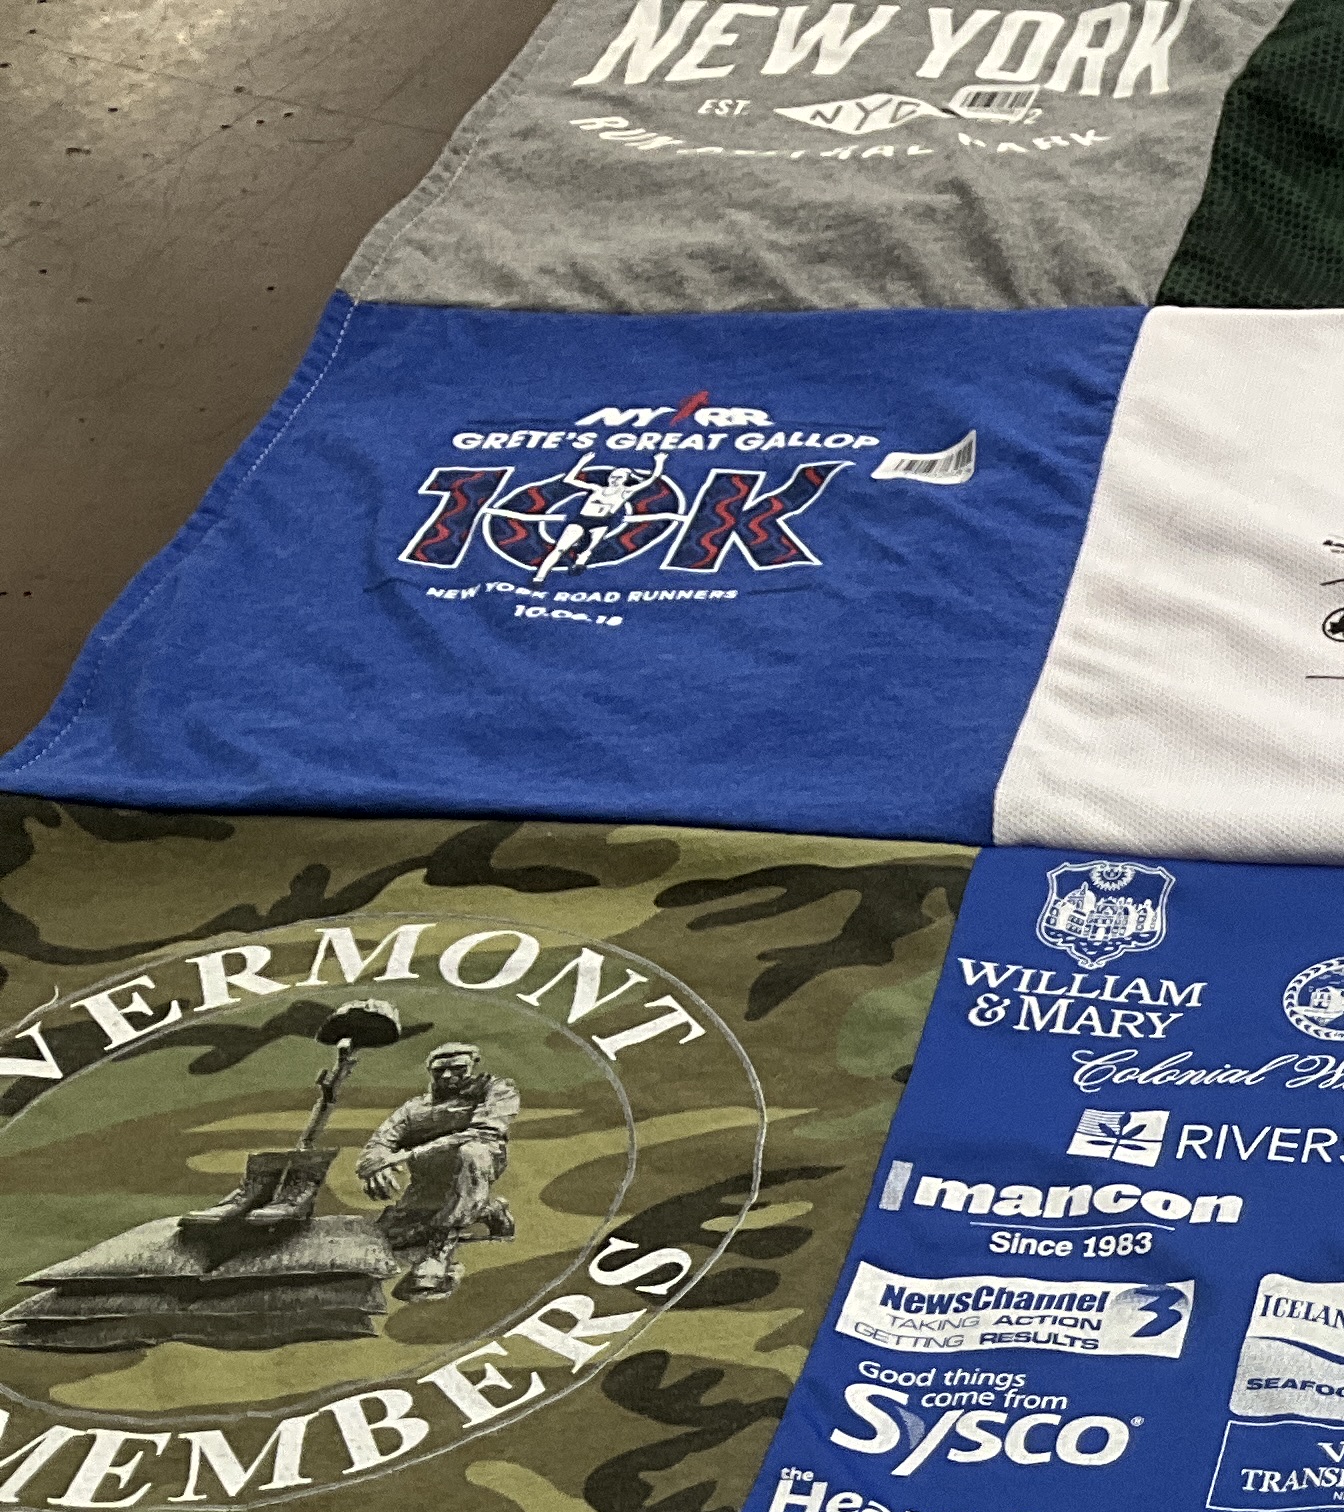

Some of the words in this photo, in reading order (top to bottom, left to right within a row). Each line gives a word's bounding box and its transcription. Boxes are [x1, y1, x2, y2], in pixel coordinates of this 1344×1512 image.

[572, 0, 900, 86] NEW
[915, 0, 1195, 97] YORK
[452, 431, 595, 452] GRETE'S
[606, 431, 722, 452] GREAT
[734, 432, 880, 451] GALLOP
[398, 461, 857, 572] 10K
[426, 586, 481, 599] NEW
[553, 591, 620, 603] ROAD
[627, 589, 738, 602] RUNNERS
[957, 958, 1207, 1007] WILLIAM
[0, 924, 706, 1081] VERMONT
[968, 994, 1010, 1027] &
[1014, 996, 1183, 1039] MARY
[1071, 1050, 1300, 1094] Colonial
[989, 1232, 1073, 1256] Since
[1082, 1231, 1153, 1258] 1983
[879, 1284, 1110, 1315] NewsChannel
[854, 1322, 964, 1349] GETTING
[979, 1332, 1099, 1350] RESULTS
[885, 1313, 980, 1331] TAKING
[993, 1313, 1101, 1331] ACTION
[858, 1361, 935, 1388] Good
[943, 1369, 1027, 1400] things
[921, 1389, 995, 1408] come
[1004, 1388, 1068, 1411] from
[781, 1467, 814, 1482] the
